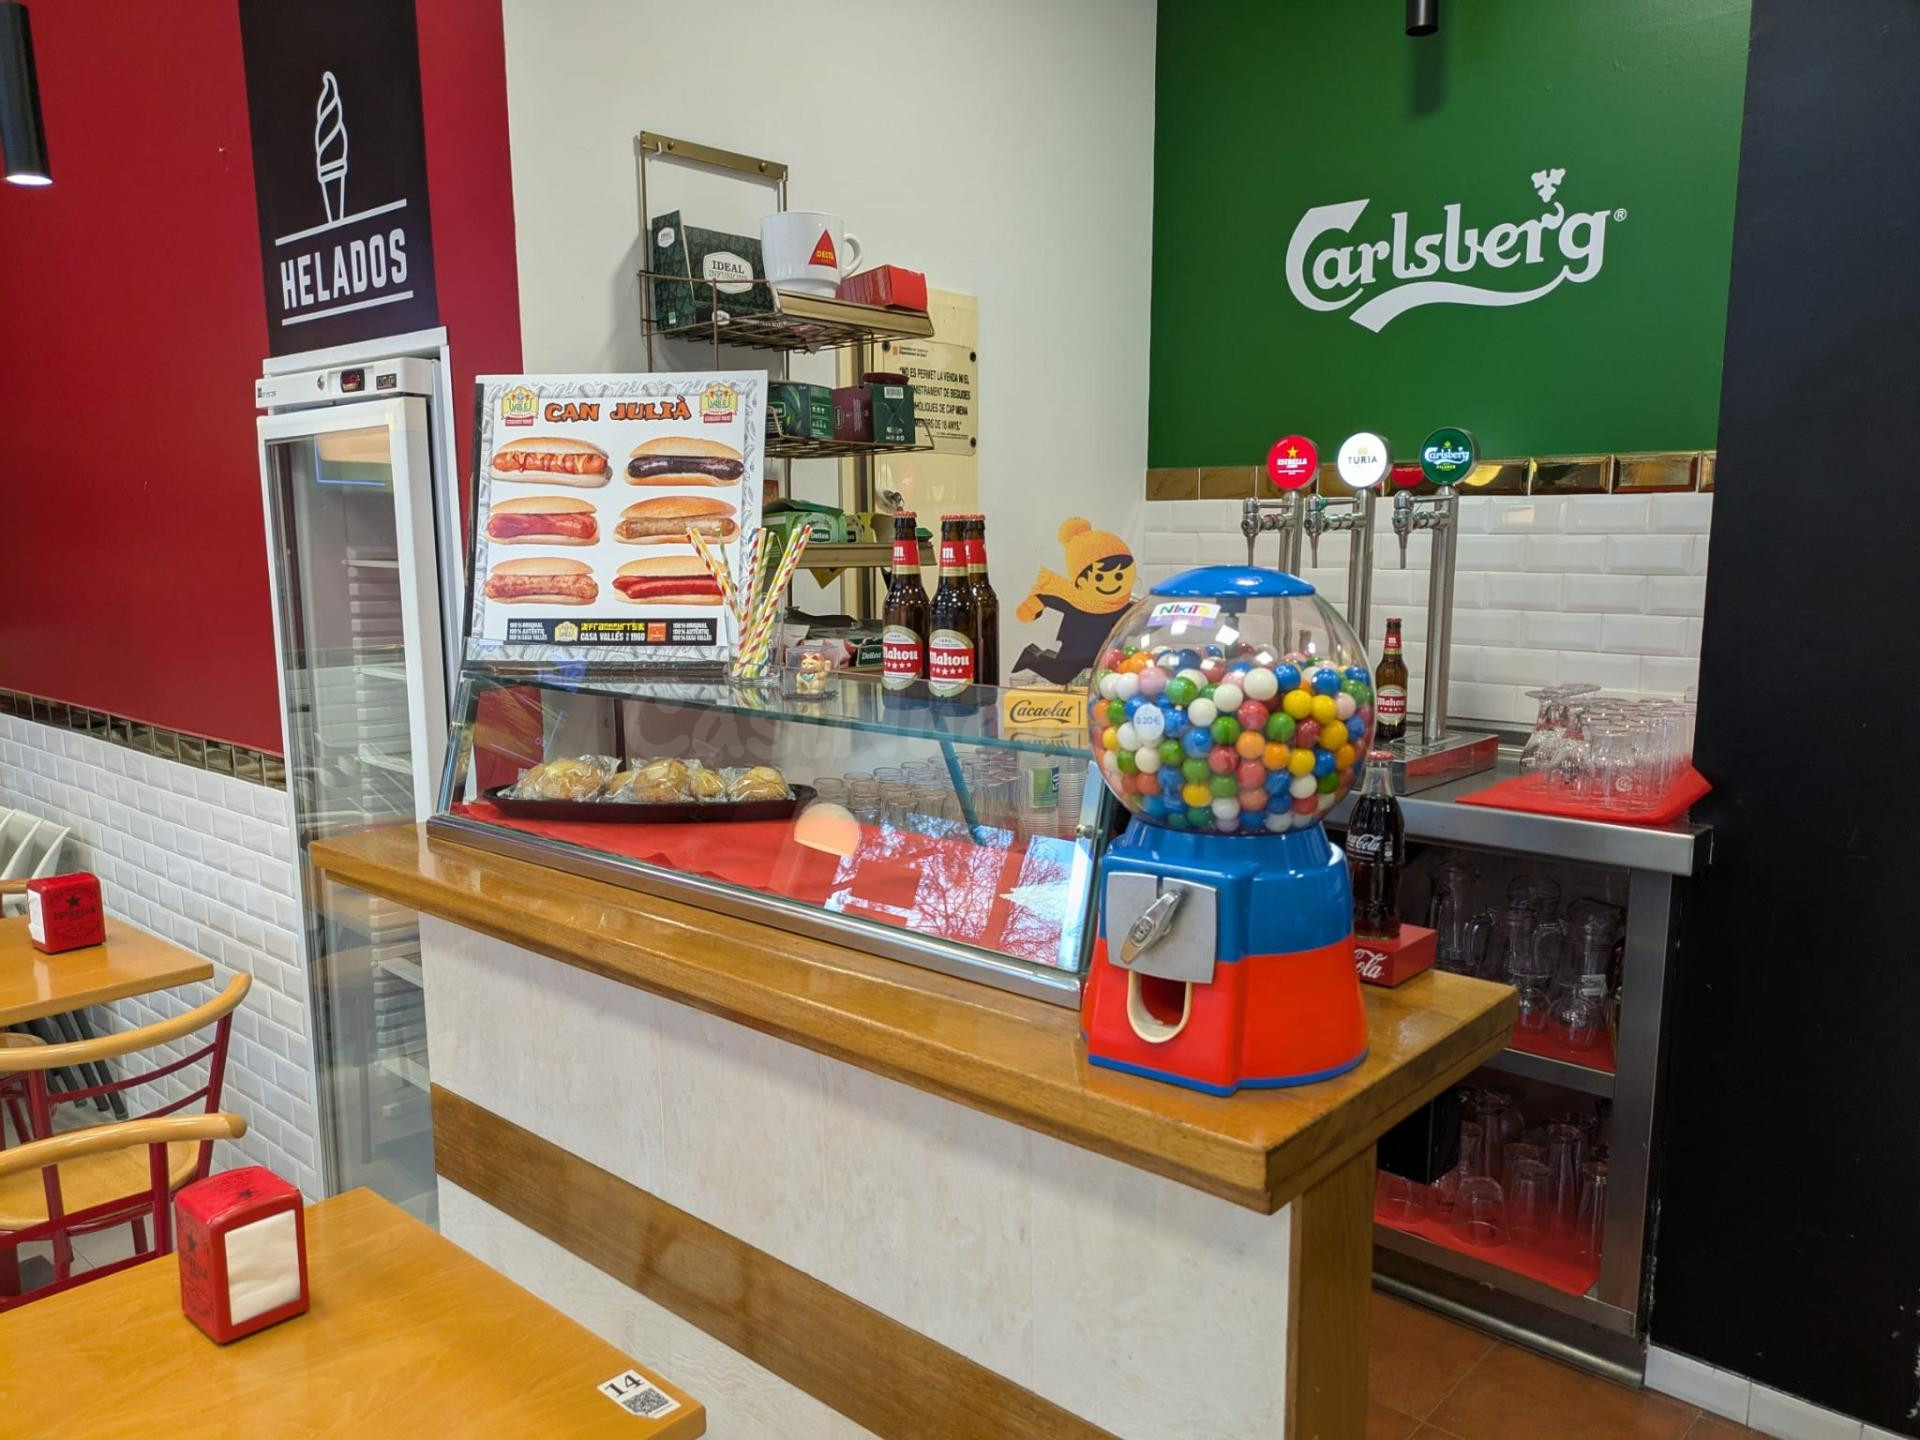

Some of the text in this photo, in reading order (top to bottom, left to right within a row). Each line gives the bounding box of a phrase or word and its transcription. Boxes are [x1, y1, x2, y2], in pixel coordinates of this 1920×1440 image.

[280, 228, 408, 311] HELADOS
[712, 260, 745, 274] IDEAL
[917, 369, 937, 380] PERMET
[544, 402, 600, 422] CAN
[609, 395, 692, 421] JULIÀ
[1347, 455, 1378, 465] TURIA
[1425, 446, 1470, 465] Carlsberg
[580, 632, 599, 641] CASA
[929, 651, 970, 666] Mahou
[1009, 700, 1074, 724] Cacaolat
[604, 1374, 645, 1398] 14
